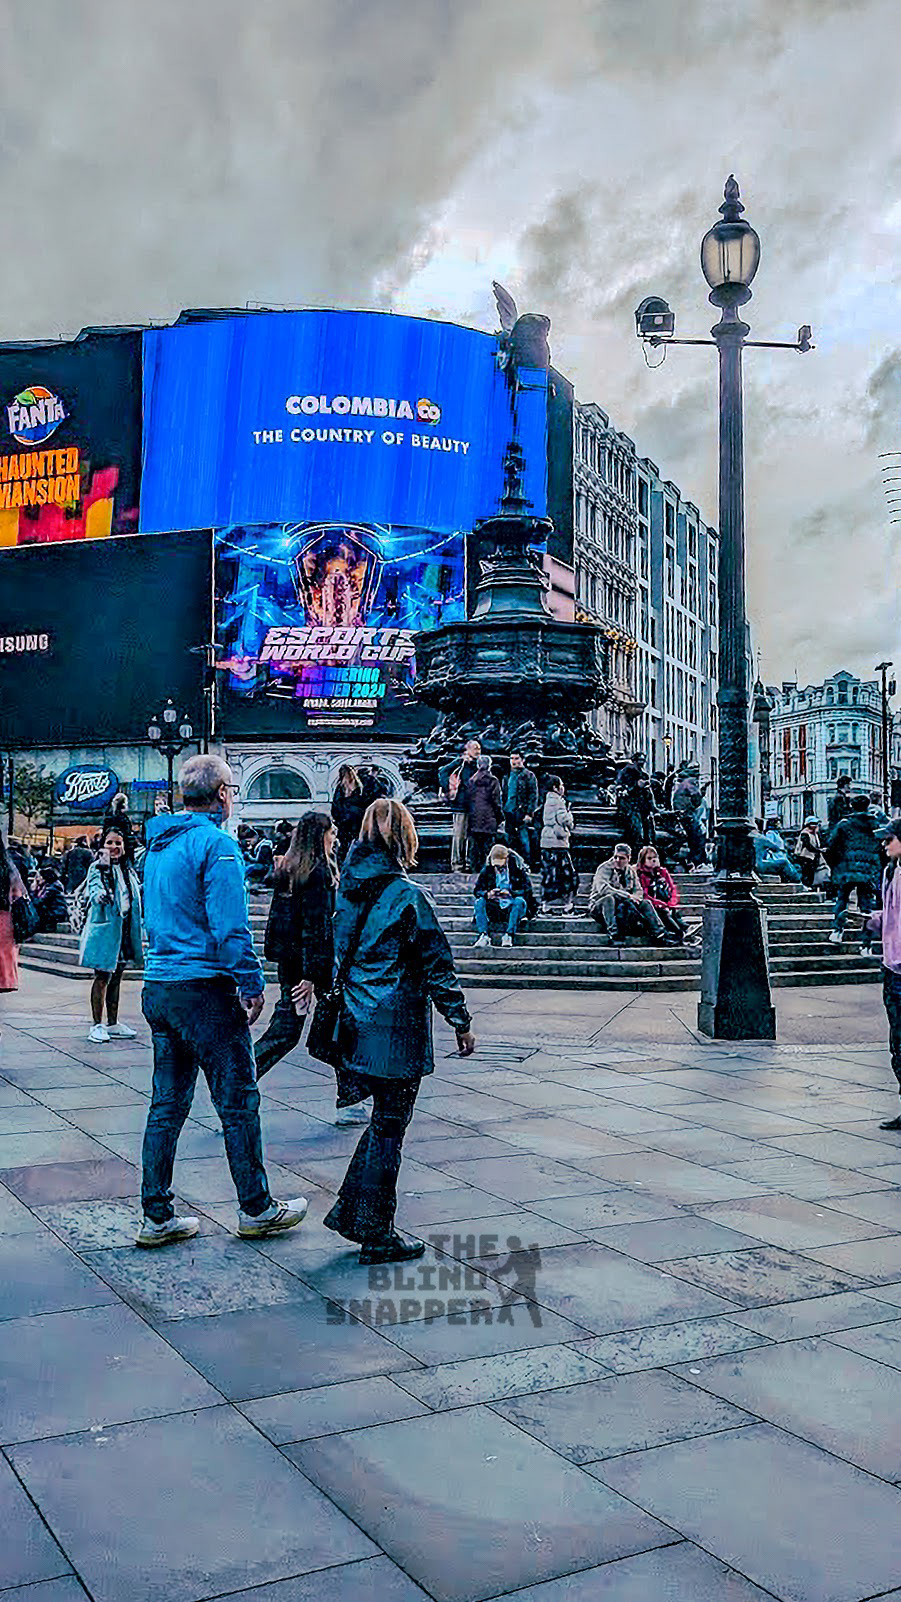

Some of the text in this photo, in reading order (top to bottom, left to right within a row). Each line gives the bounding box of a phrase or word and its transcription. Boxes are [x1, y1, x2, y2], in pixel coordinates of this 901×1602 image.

[7, 398, 66, 434] FANTA
[286, 395, 414, 420] COLOMBIA
[252, 428, 470, 455] THE COUNTRY OF BEAUTY
[0, 447, 79, 483] HAUNTED
[0, 633, 49, 653] SUNG
[264, 627, 420, 647] ESPORTS
[259, 645, 416, 661] WORLD CUP
[351, 683, 387, 698] 2024
[60, 771, 110, 803] Boots
